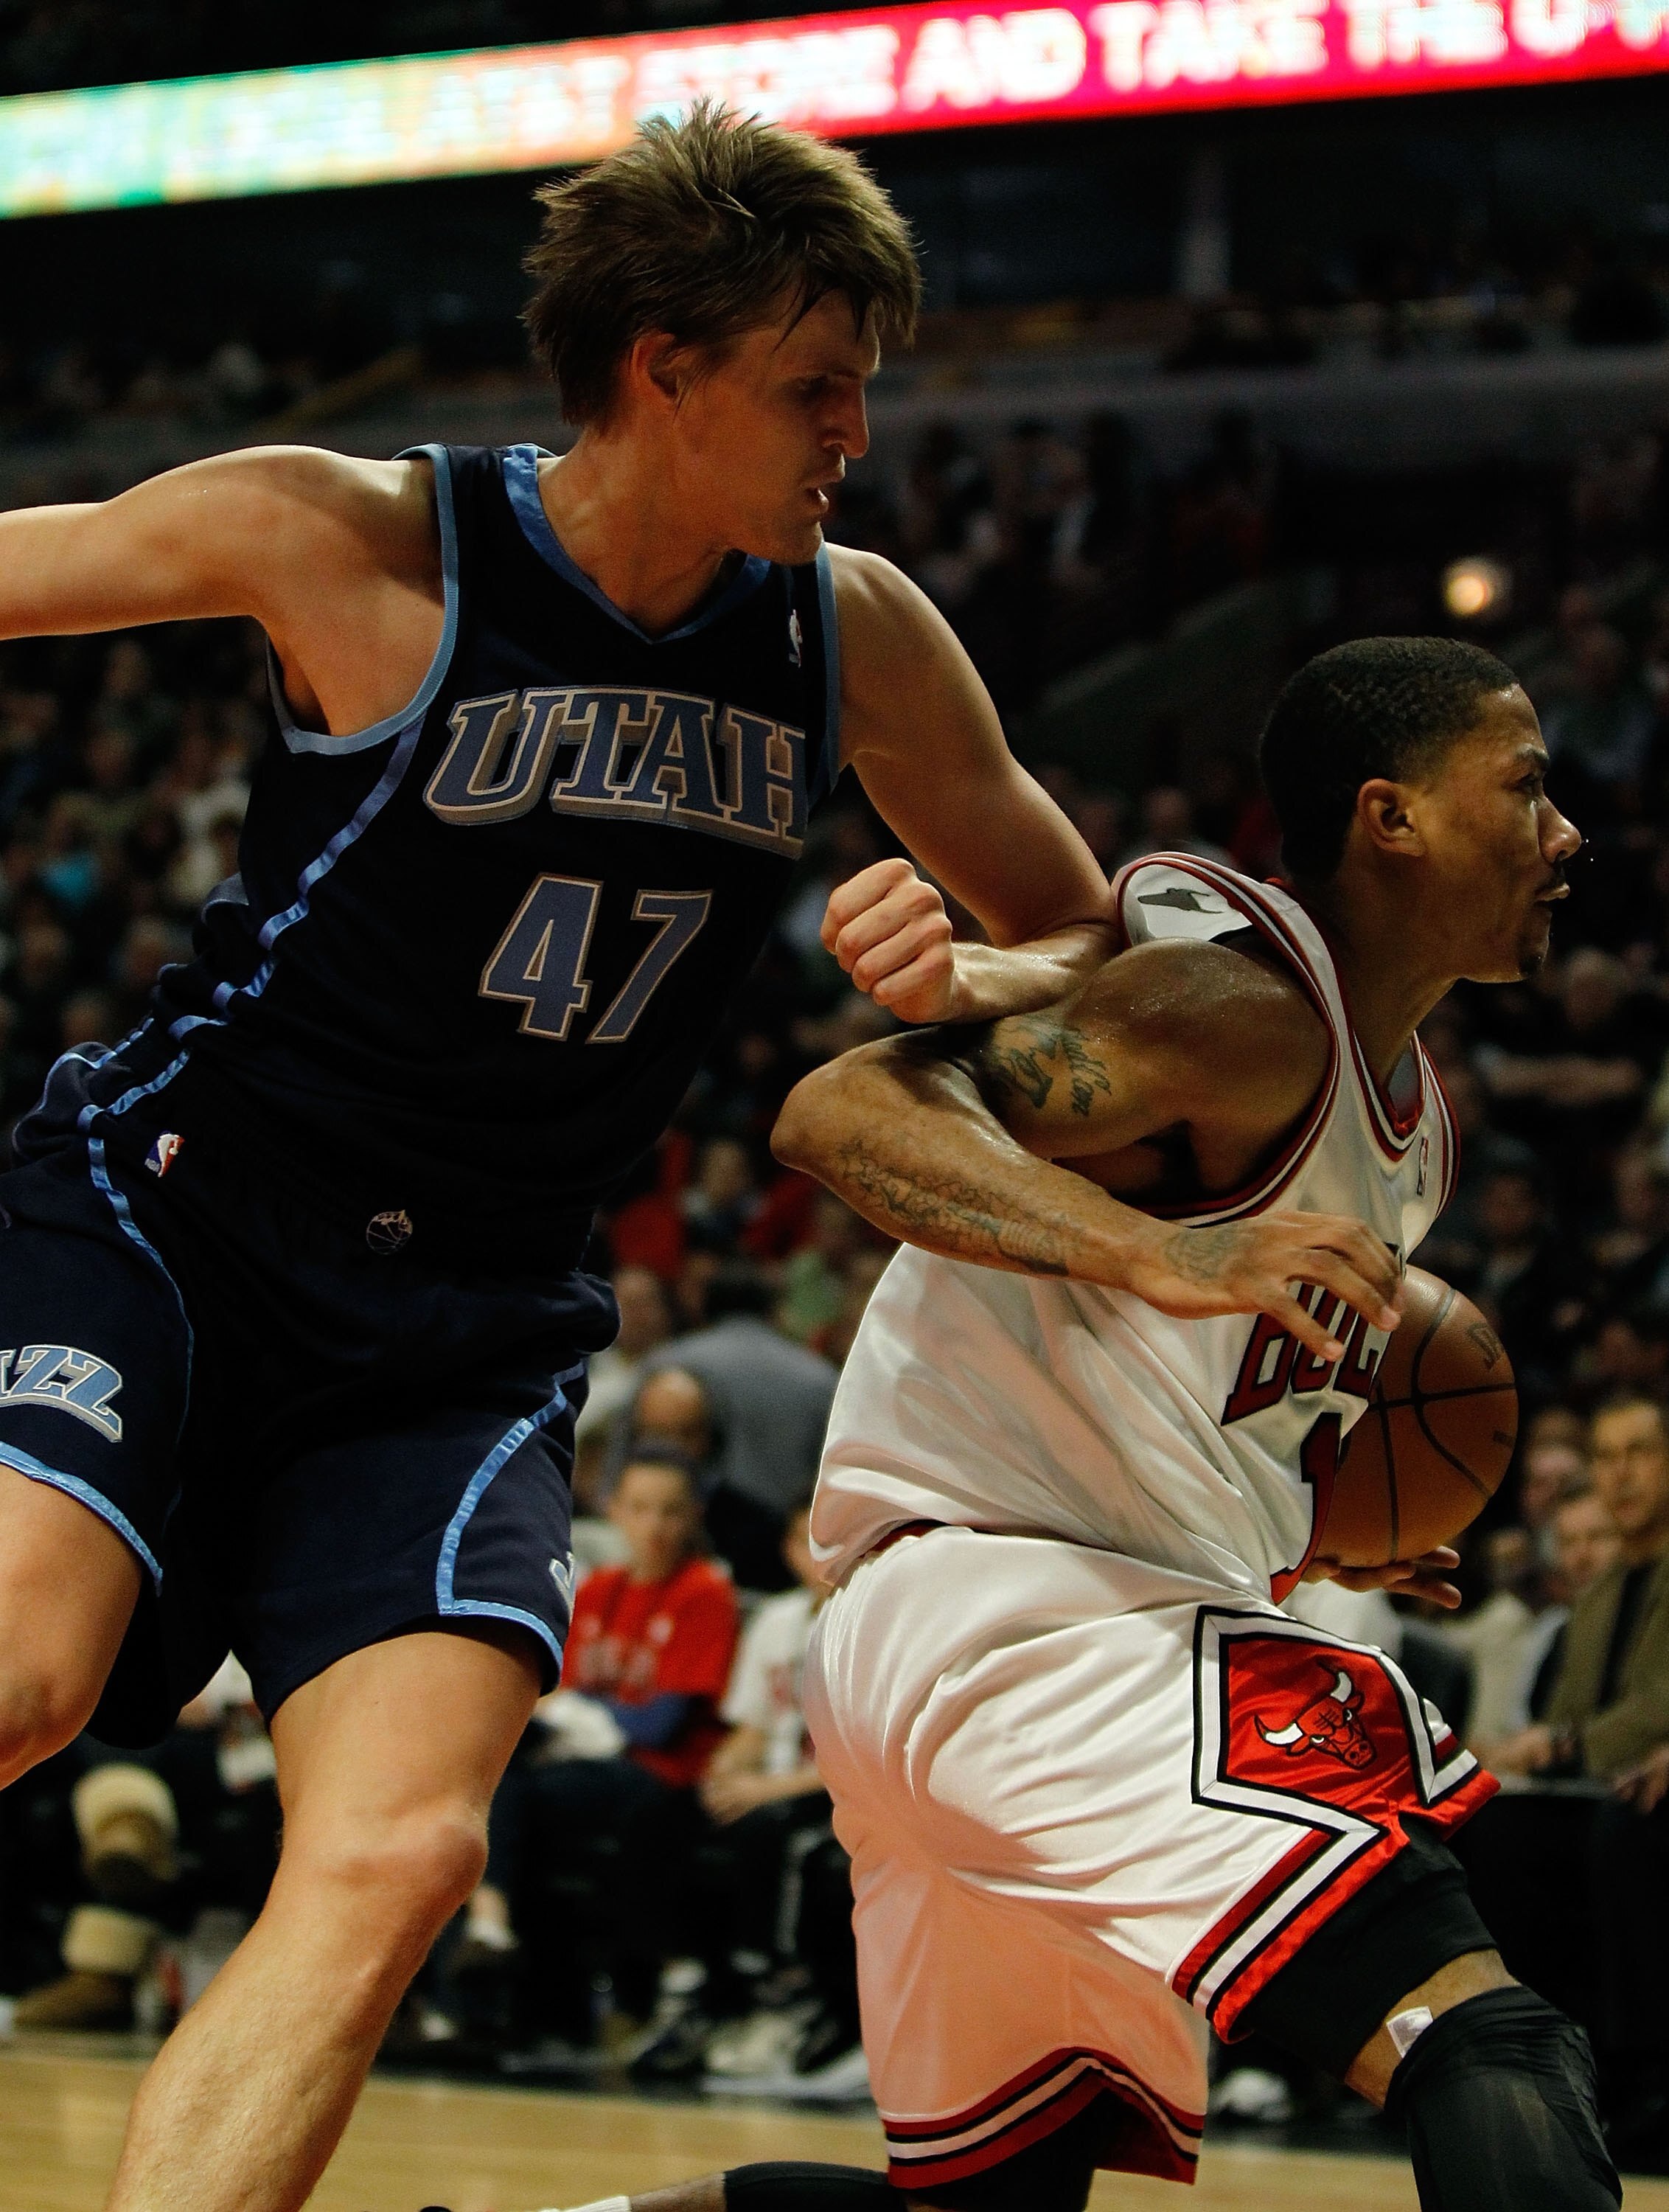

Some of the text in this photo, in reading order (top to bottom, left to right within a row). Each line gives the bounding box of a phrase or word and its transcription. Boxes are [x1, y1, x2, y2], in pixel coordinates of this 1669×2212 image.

[901, 9, 1087, 112] AND
[1090, 0, 1325, 90] TAKE
[1348, 0, 1508, 69] THE
[423, 684, 806, 860] UTAH
[478, 872, 714, 1044] 47
[0, 1343, 124, 1443] ZZ
